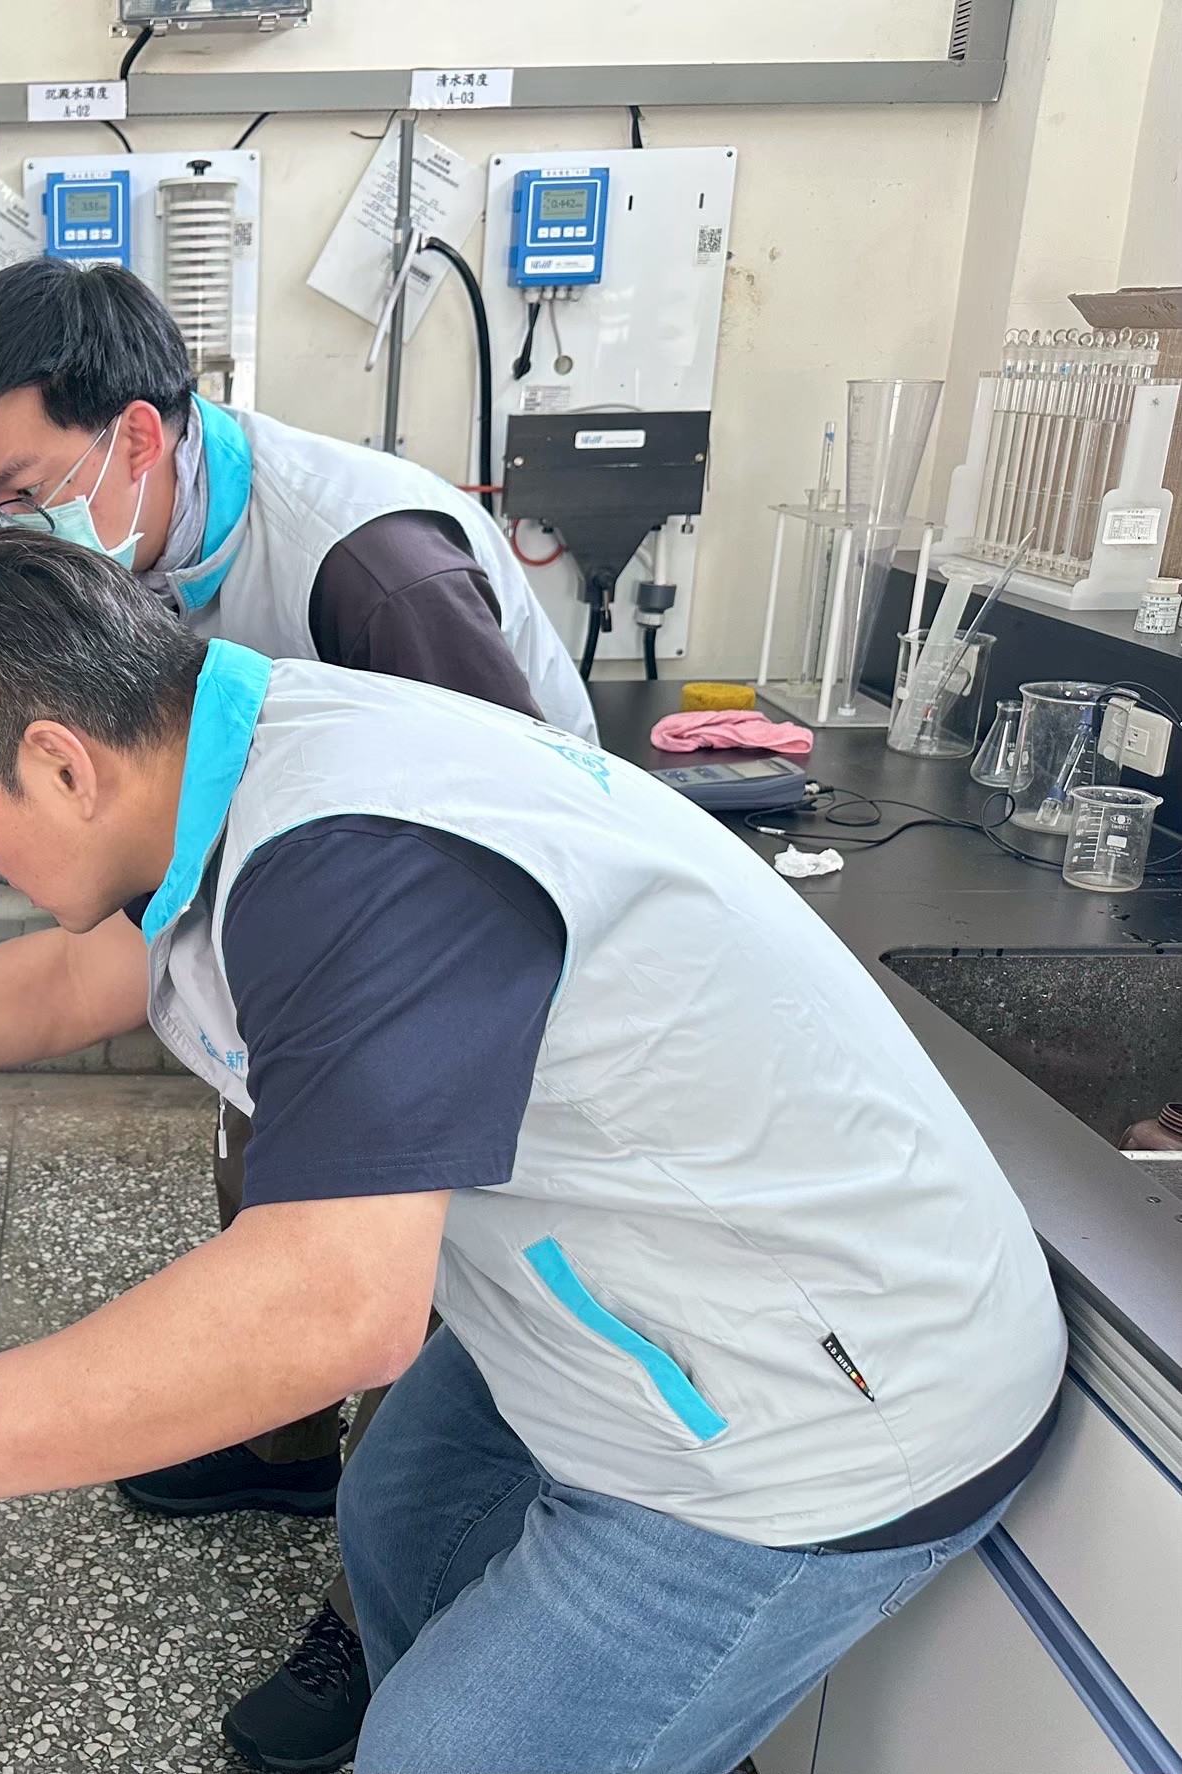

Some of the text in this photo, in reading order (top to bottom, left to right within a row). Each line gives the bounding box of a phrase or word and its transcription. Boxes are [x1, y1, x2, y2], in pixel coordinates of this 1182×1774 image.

[436, 73, 489, 88] 清水濁度
[45, 86, 108, 100] 沉澱水濁度
[447, 91, 474, 104] A-03
[64, 104, 90, 117] A-02
[225, 1049, 245, 1071] 新
